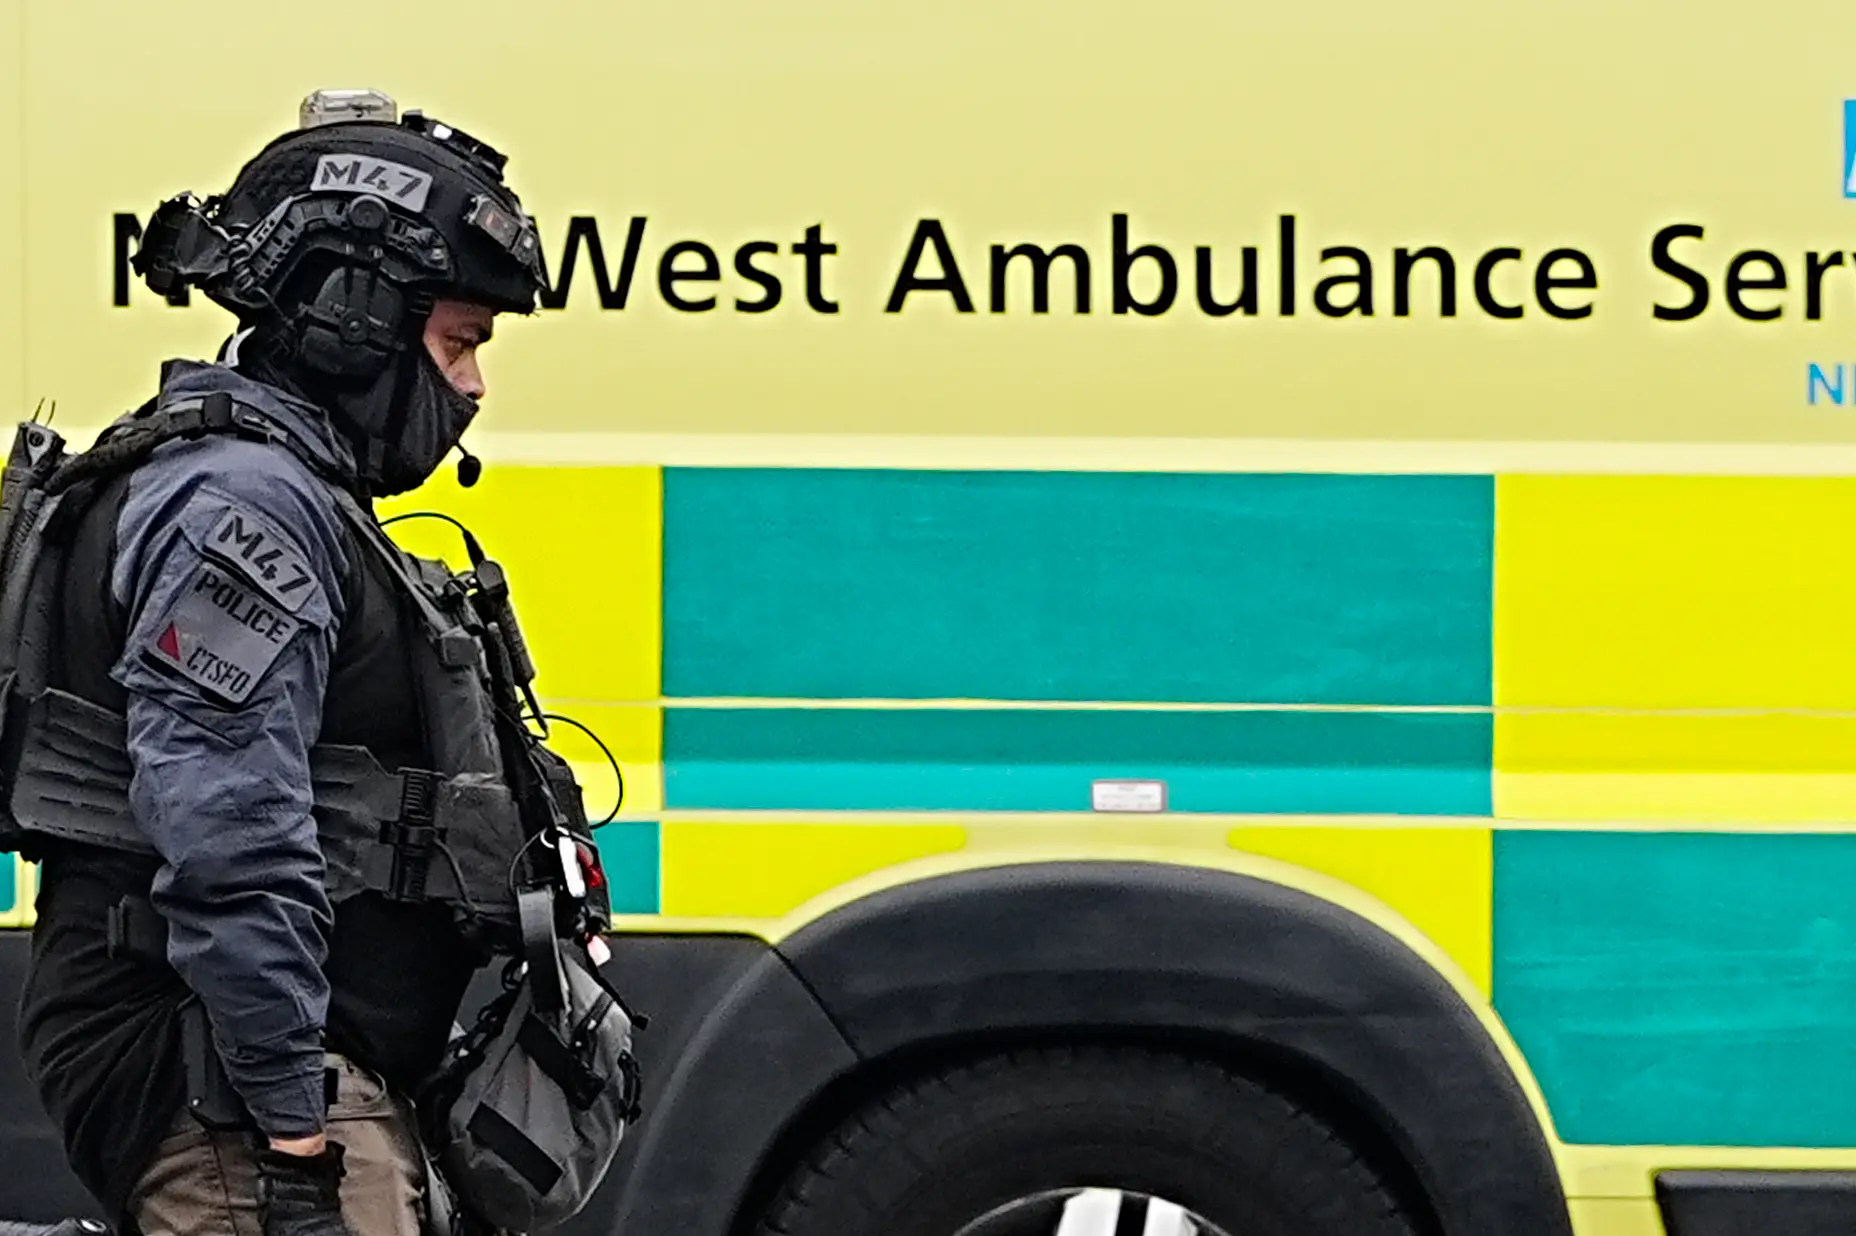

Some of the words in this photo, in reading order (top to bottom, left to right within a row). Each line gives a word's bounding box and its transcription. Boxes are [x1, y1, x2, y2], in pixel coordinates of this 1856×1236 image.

[320, 160, 423, 198] M47
[528, 215, 840, 314] West
[885, 213, 1598, 320] Ambulance
[1650, 223, 1856, 322] Ser
[217, 515, 311, 594] M47
[194, 569, 291, 644] POLICE
[186, 646, 252, 695] CTSFO
